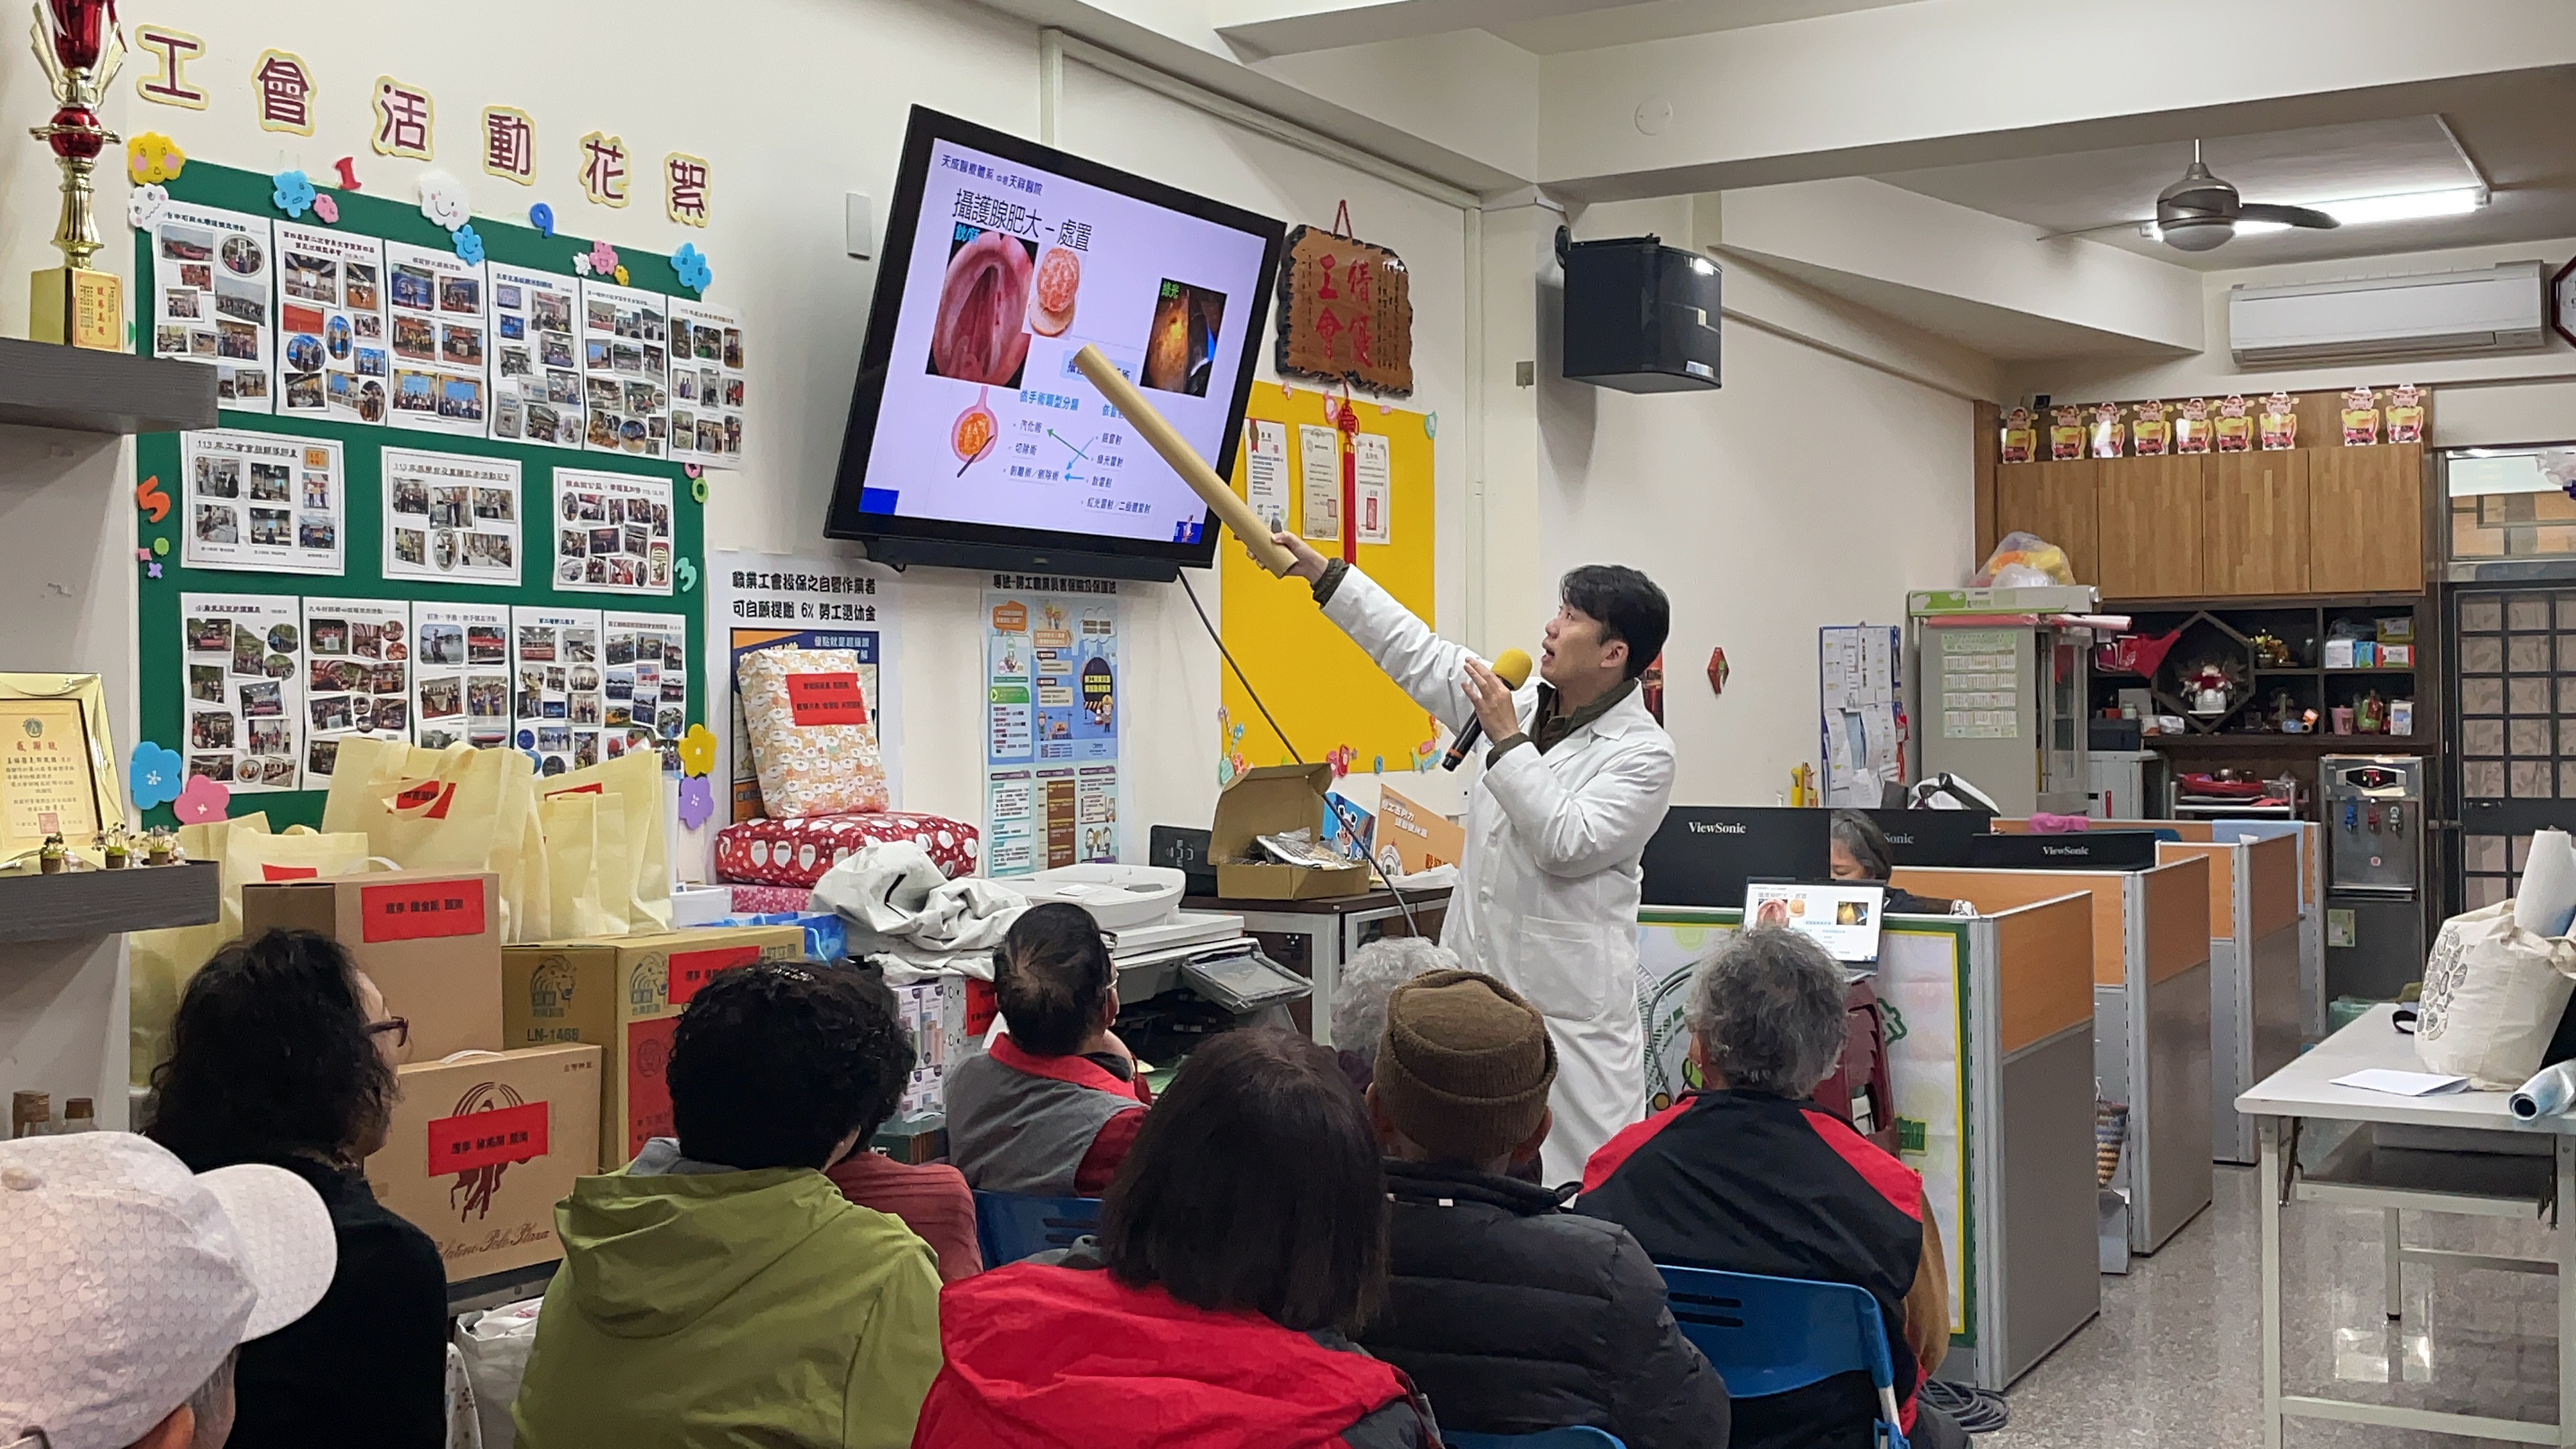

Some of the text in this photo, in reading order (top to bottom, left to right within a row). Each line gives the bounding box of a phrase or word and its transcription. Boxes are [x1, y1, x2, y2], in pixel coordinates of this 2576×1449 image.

[144, 32, 706, 219] 工會活動花絮
[801, 602, 814, 619] 6%
[1688, 821, 1747, 834] ViewSonic
[1883, 833, 1914, 845] Sonic
[2043, 846, 2090, 855] ViewSonic
